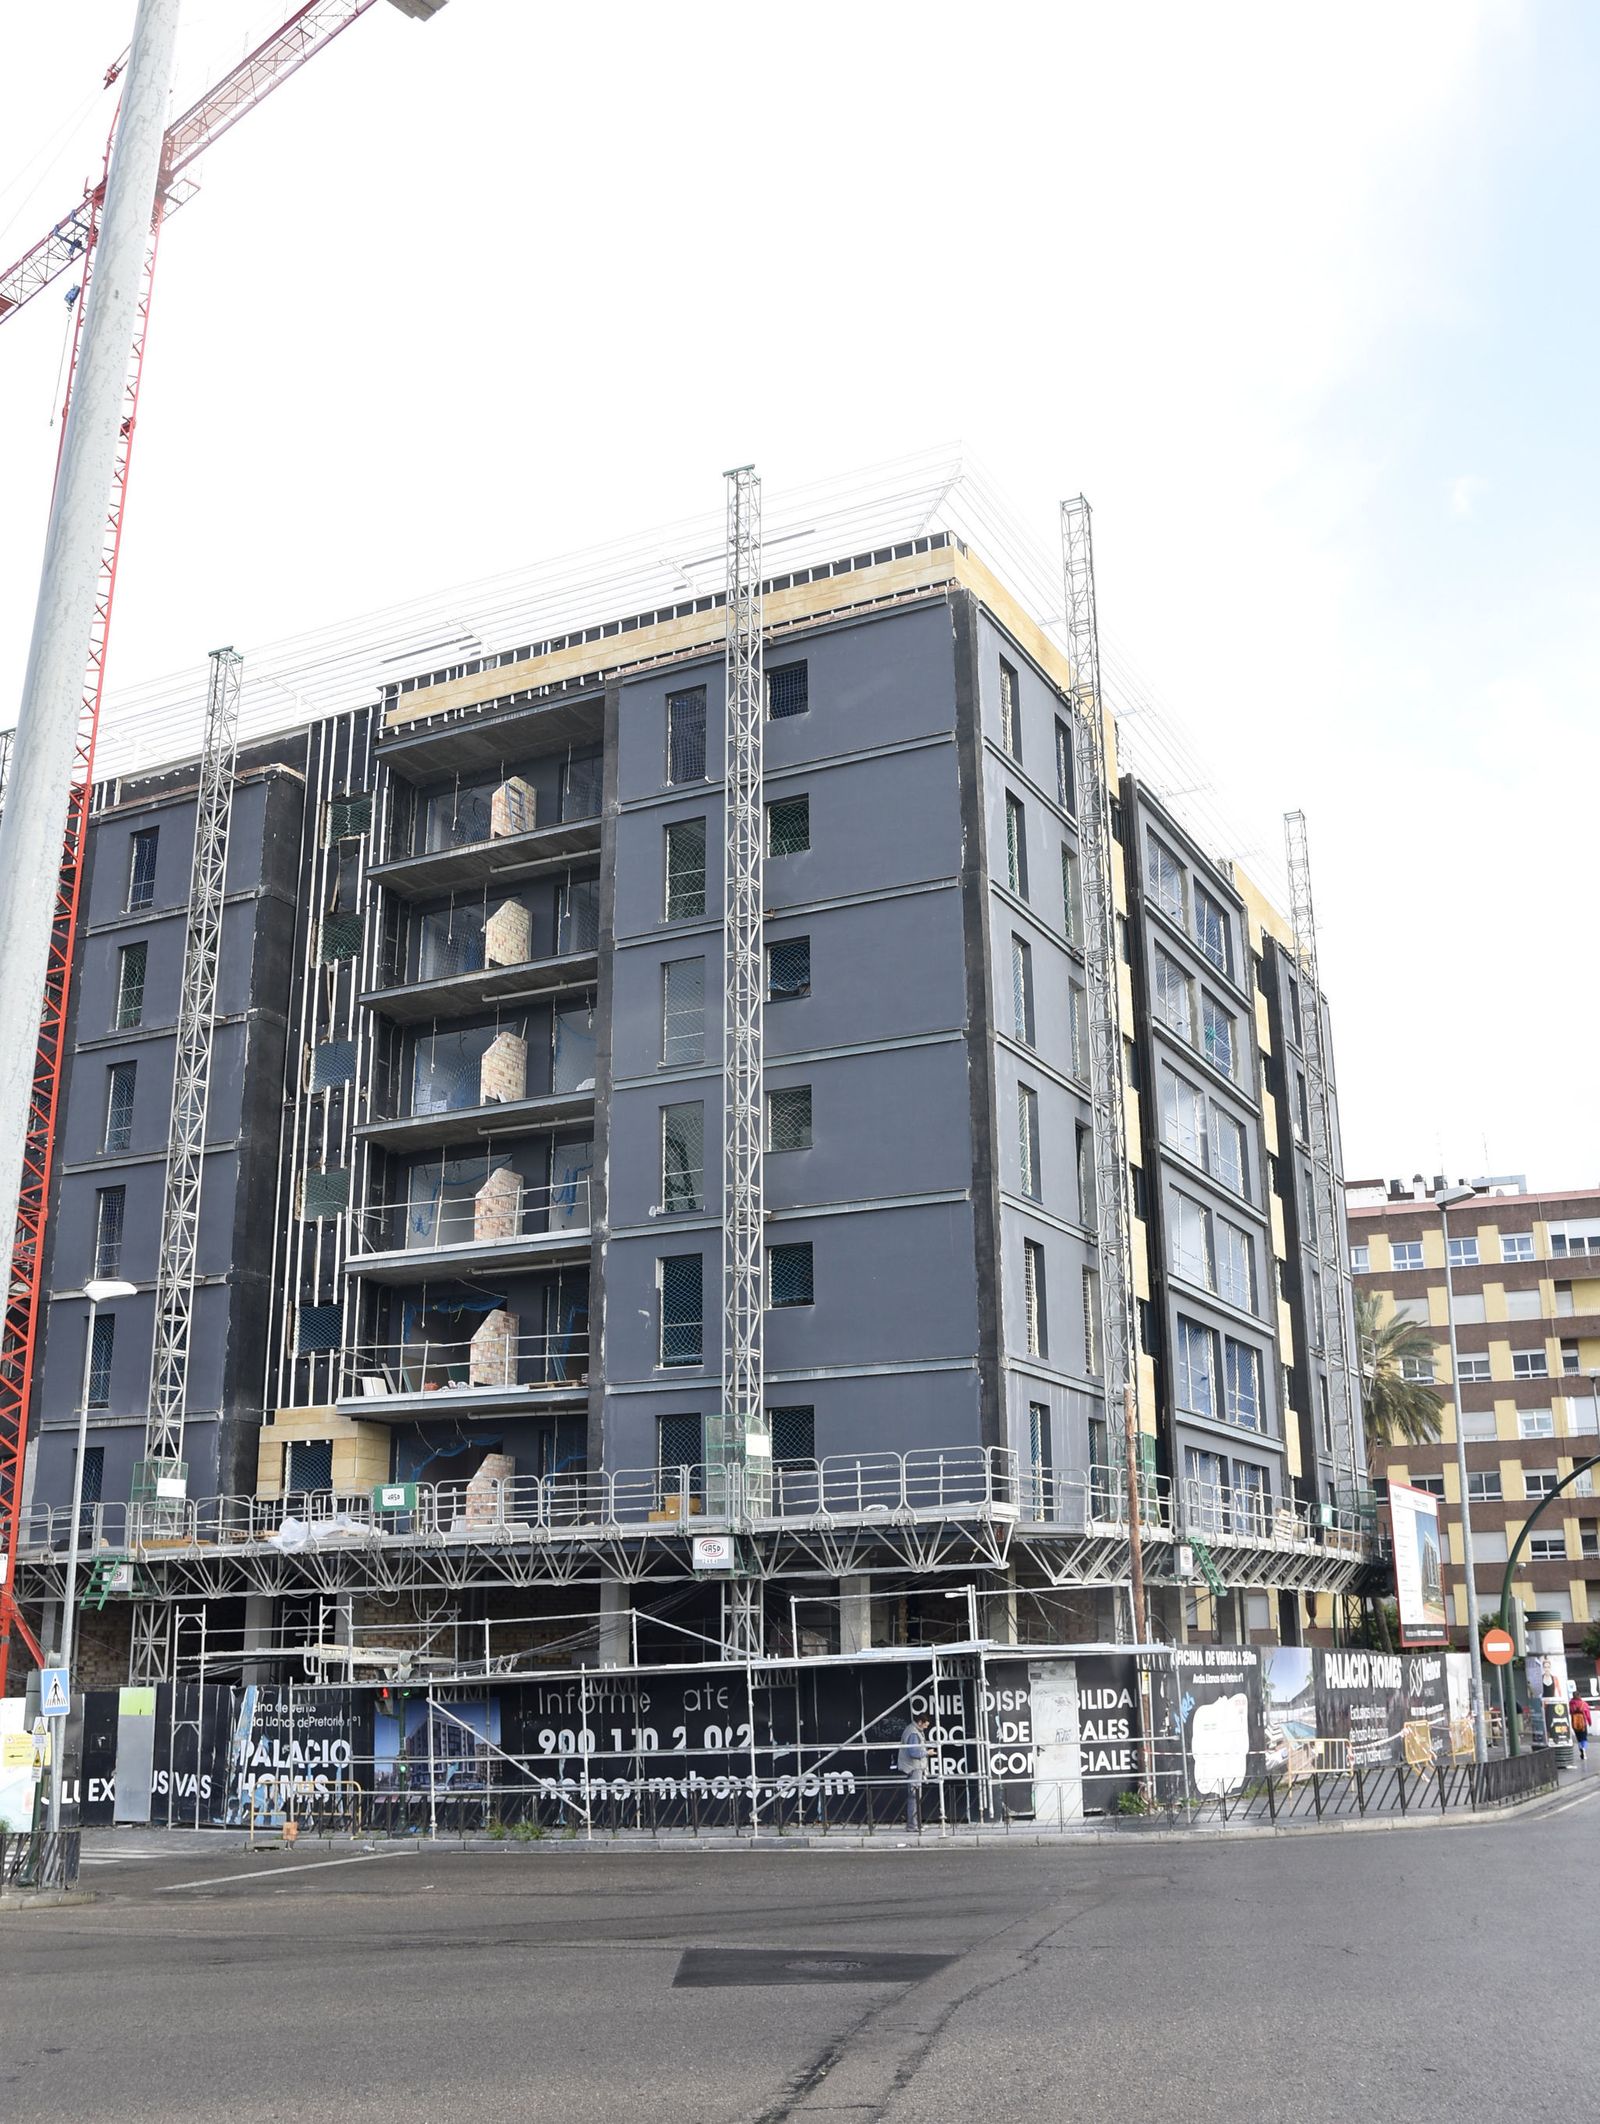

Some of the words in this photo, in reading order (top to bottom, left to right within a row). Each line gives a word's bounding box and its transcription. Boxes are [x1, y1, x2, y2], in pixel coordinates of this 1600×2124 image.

[1205, 1651, 1215, 1666] DE
[1324, 1653, 1369, 1689] PALACIO
[1370, 1655, 1402, 1689] HOMES
[538, 1729, 596, 1754] 900
[1002, 1721, 1030, 1743] DE
[239, 1739, 352, 1769] PALACIO
